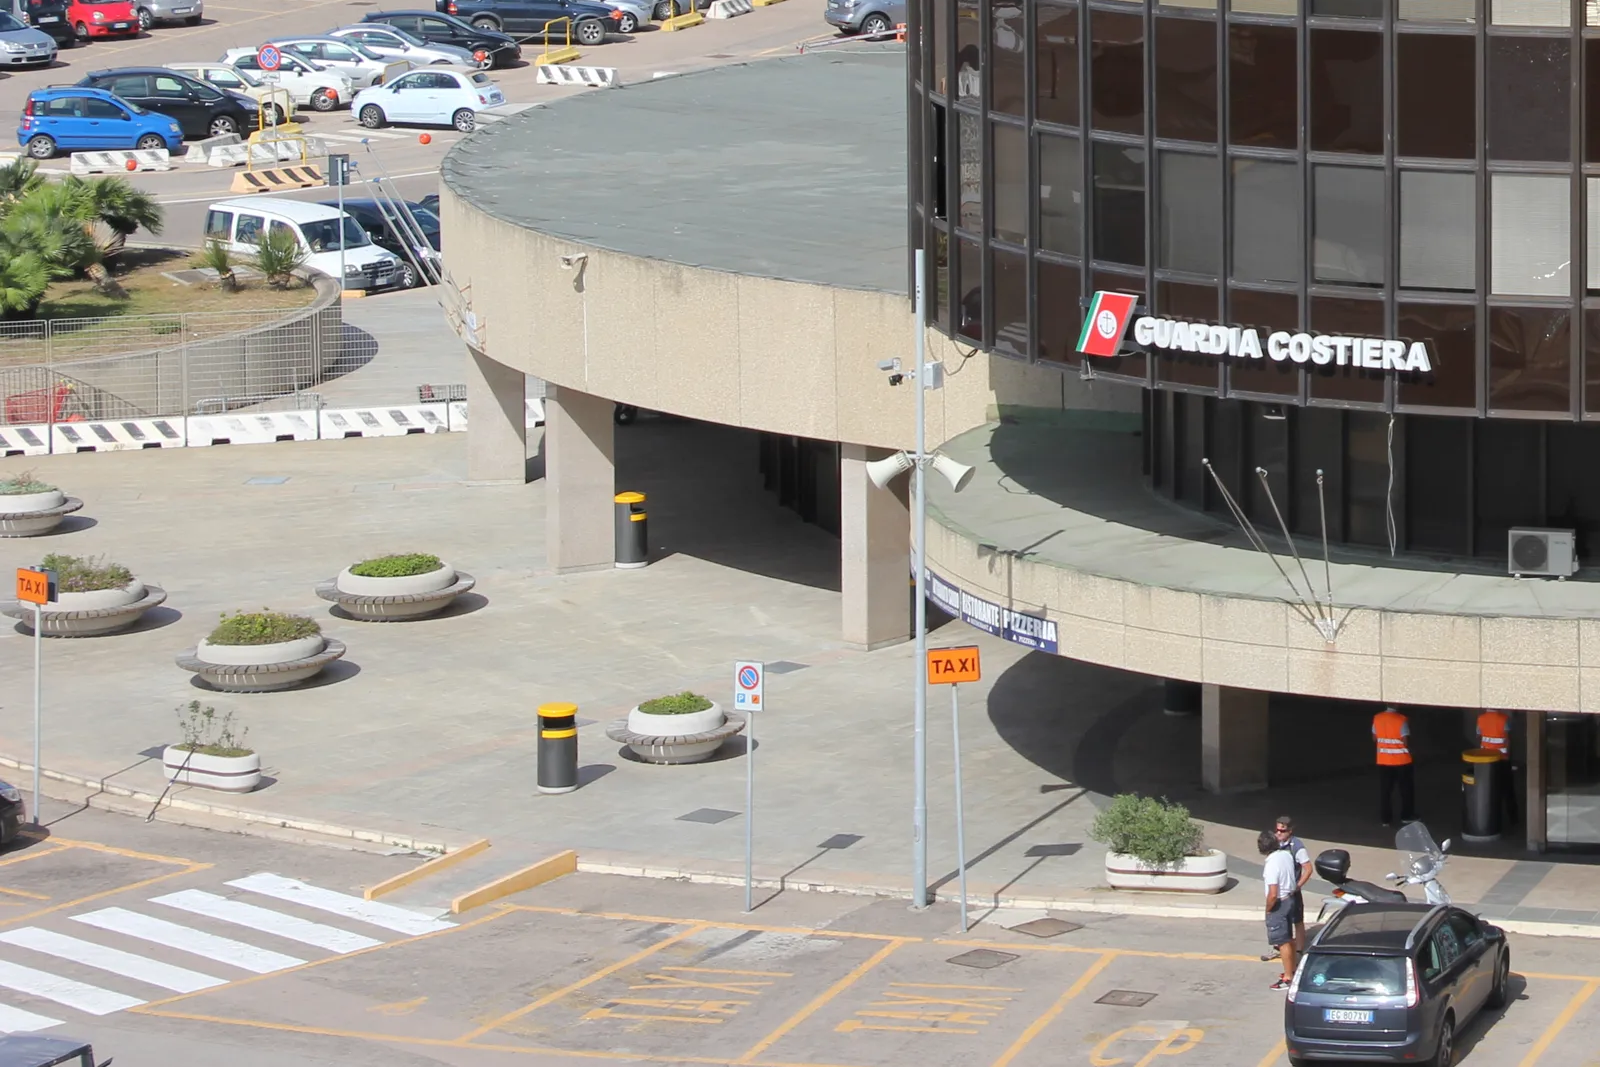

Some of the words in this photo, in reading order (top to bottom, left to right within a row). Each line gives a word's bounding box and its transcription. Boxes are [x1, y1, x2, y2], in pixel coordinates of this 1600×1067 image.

[1133, 315, 1264, 360] GUARDIA
[1267, 331, 1432, 372] COSTIERA
[18, 577, 45, 596] TAXI
[962, 591, 1001, 628] RISTORANTE
[1003, 609, 1057, 642] PIZZERIA
[932, 657, 976, 675] TAXI
[738, 694, 744, 702] P
